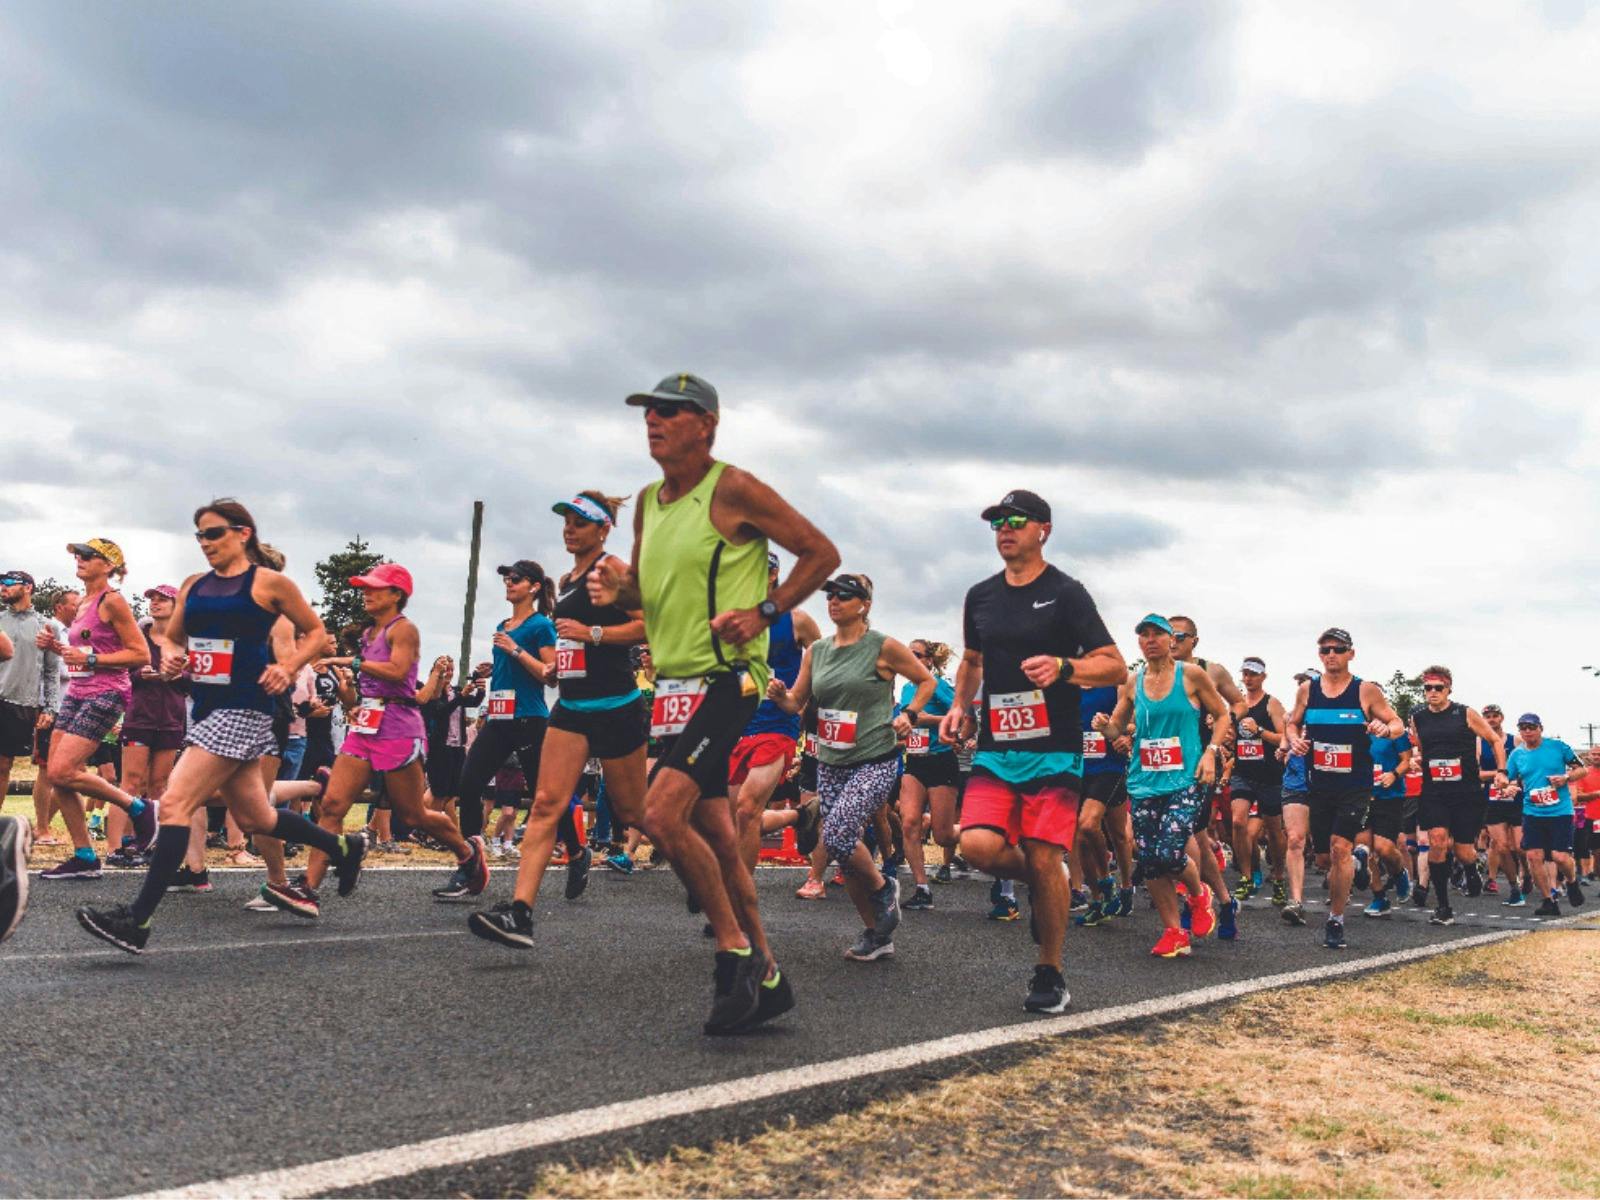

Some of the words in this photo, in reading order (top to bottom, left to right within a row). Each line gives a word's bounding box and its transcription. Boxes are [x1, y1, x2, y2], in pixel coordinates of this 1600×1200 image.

[194, 653, 213, 673] 39
[663, 695, 692, 723] 193
[998, 707, 1035, 731] 203
[824, 721, 840, 741] 97
[1146, 749, 1172, 765] 145
[1324, 752, 1338, 767] 91
[1438, 767, 1453, 777] 23
